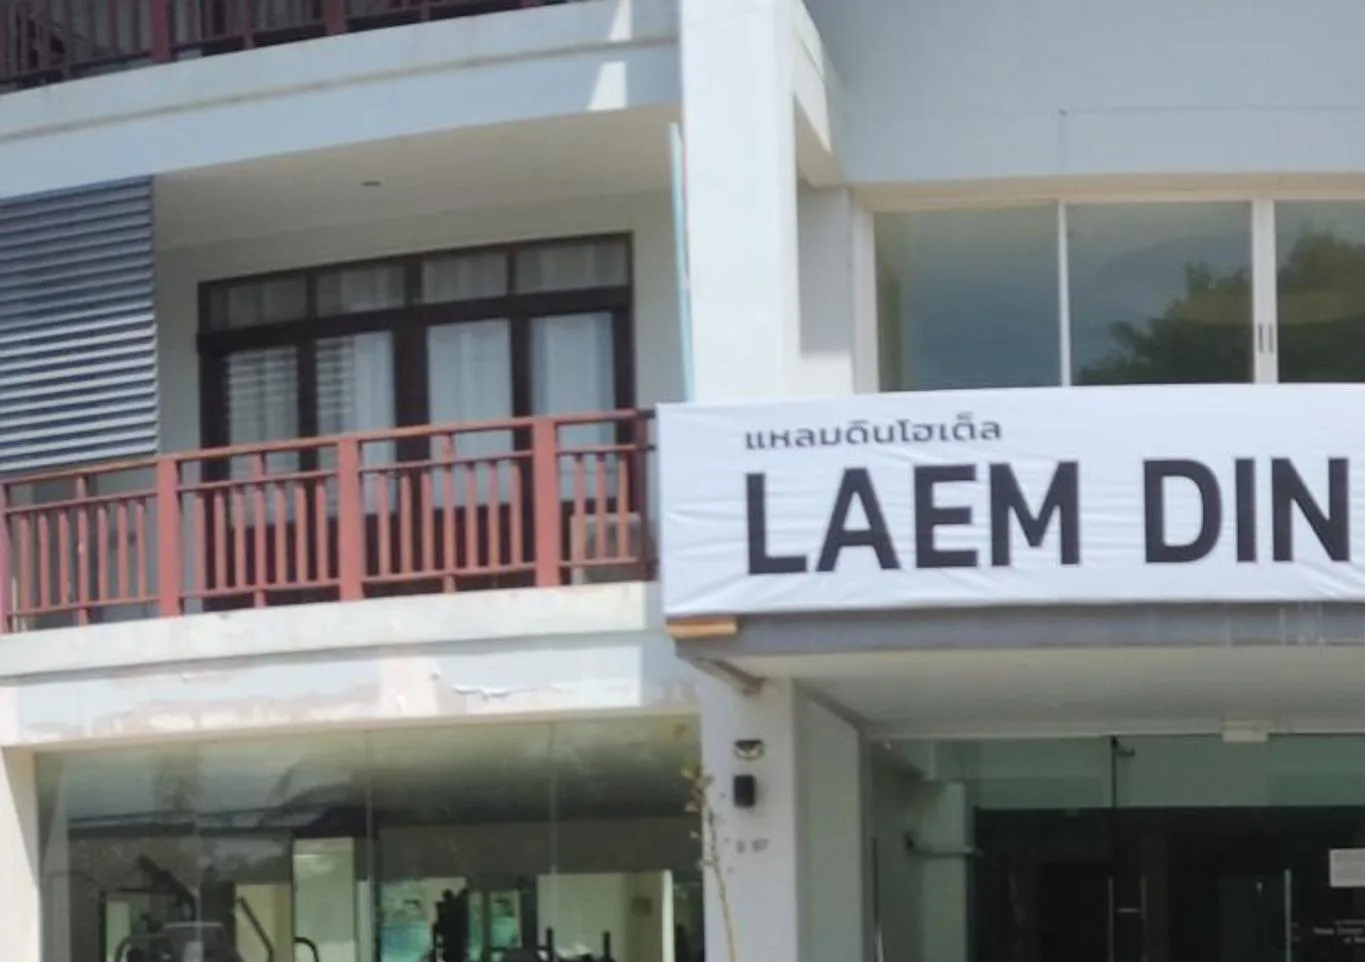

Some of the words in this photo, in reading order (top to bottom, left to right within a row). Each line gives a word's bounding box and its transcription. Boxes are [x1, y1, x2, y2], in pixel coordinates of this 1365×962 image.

[745, 411, 1002, 450] แหลมดินโฮเต็ล
[745, 460, 1080, 575] LAEM
[1143, 457, 1350, 564] DIN
